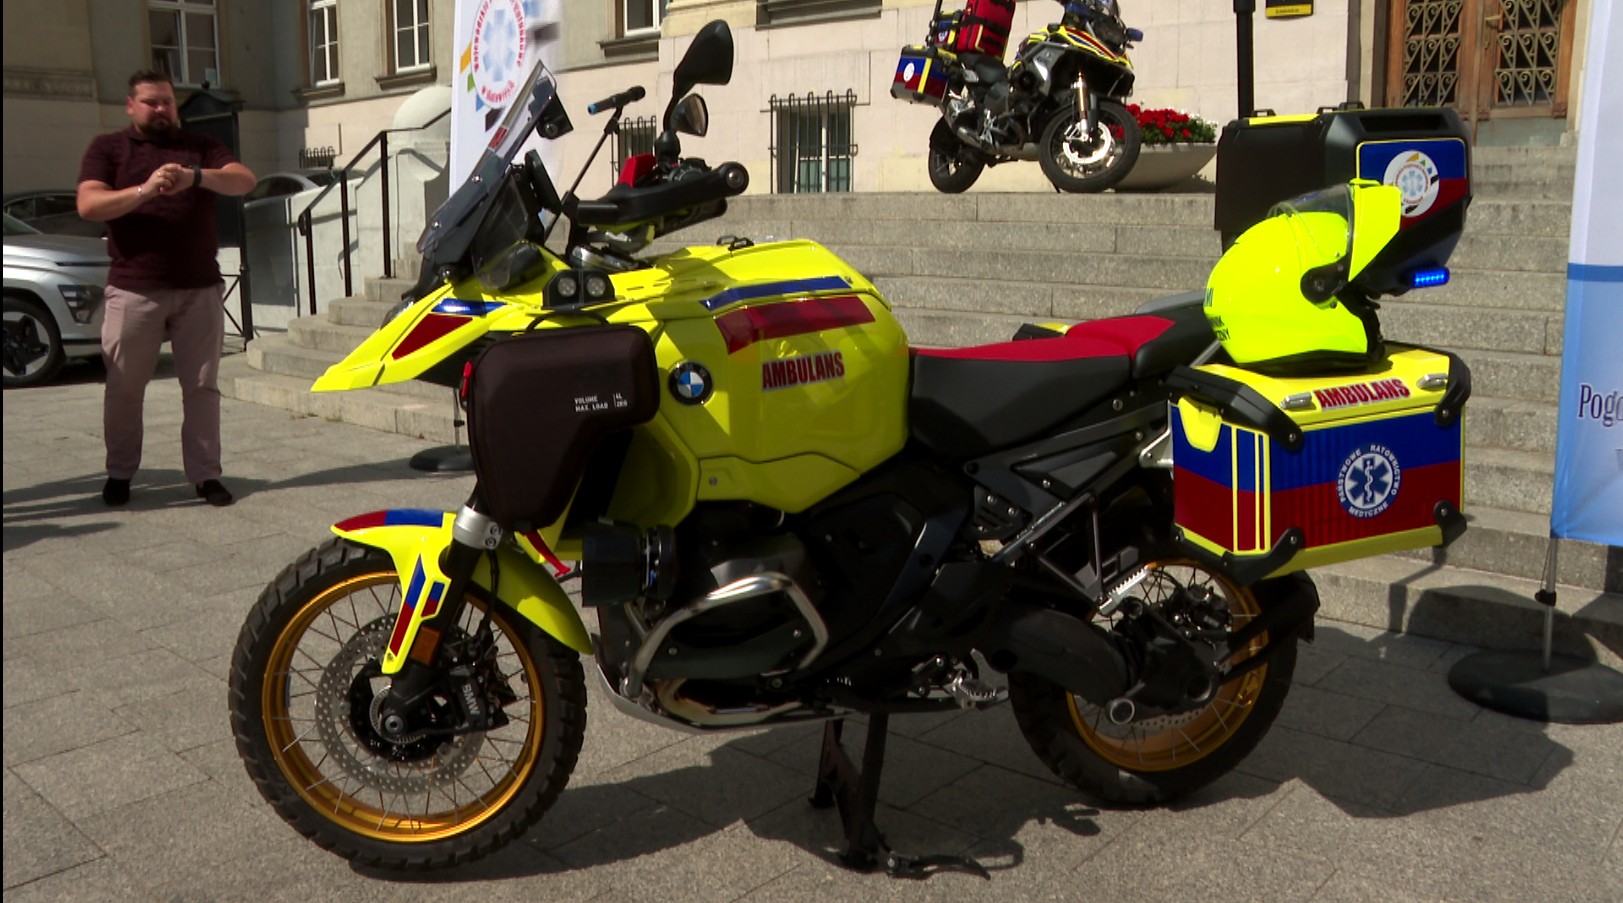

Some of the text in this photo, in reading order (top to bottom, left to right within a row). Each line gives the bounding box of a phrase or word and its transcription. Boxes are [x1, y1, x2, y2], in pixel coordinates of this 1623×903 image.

[761, 351, 845, 390] AMBULANS
[574, 395, 598, 404] VOLUME
[1313, 378, 1411, 410] AMBULANS
[592, 402, 609, 411] LOAD
[1348, 501, 1388, 517] MEDYCZNE
[462, 683, 480, 715] BMW
